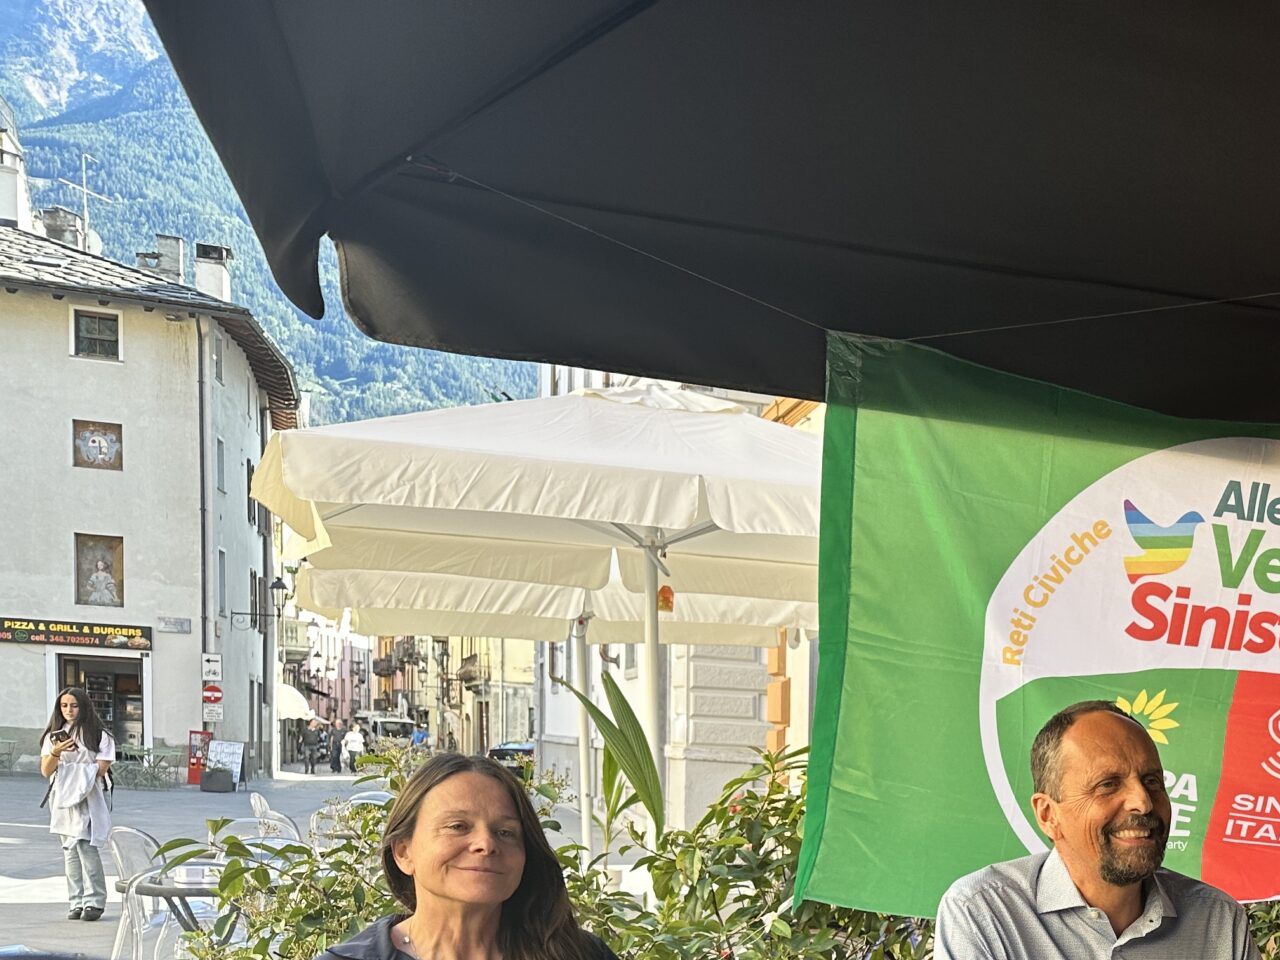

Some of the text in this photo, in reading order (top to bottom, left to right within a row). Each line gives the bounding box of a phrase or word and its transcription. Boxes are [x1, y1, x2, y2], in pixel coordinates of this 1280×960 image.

[1002, 519, 1113, 667] Reti Civiche
[4, 620, 142, 637] PIZZA & GRILL & BURGERS
[1166, 841, 1188, 852] arty
